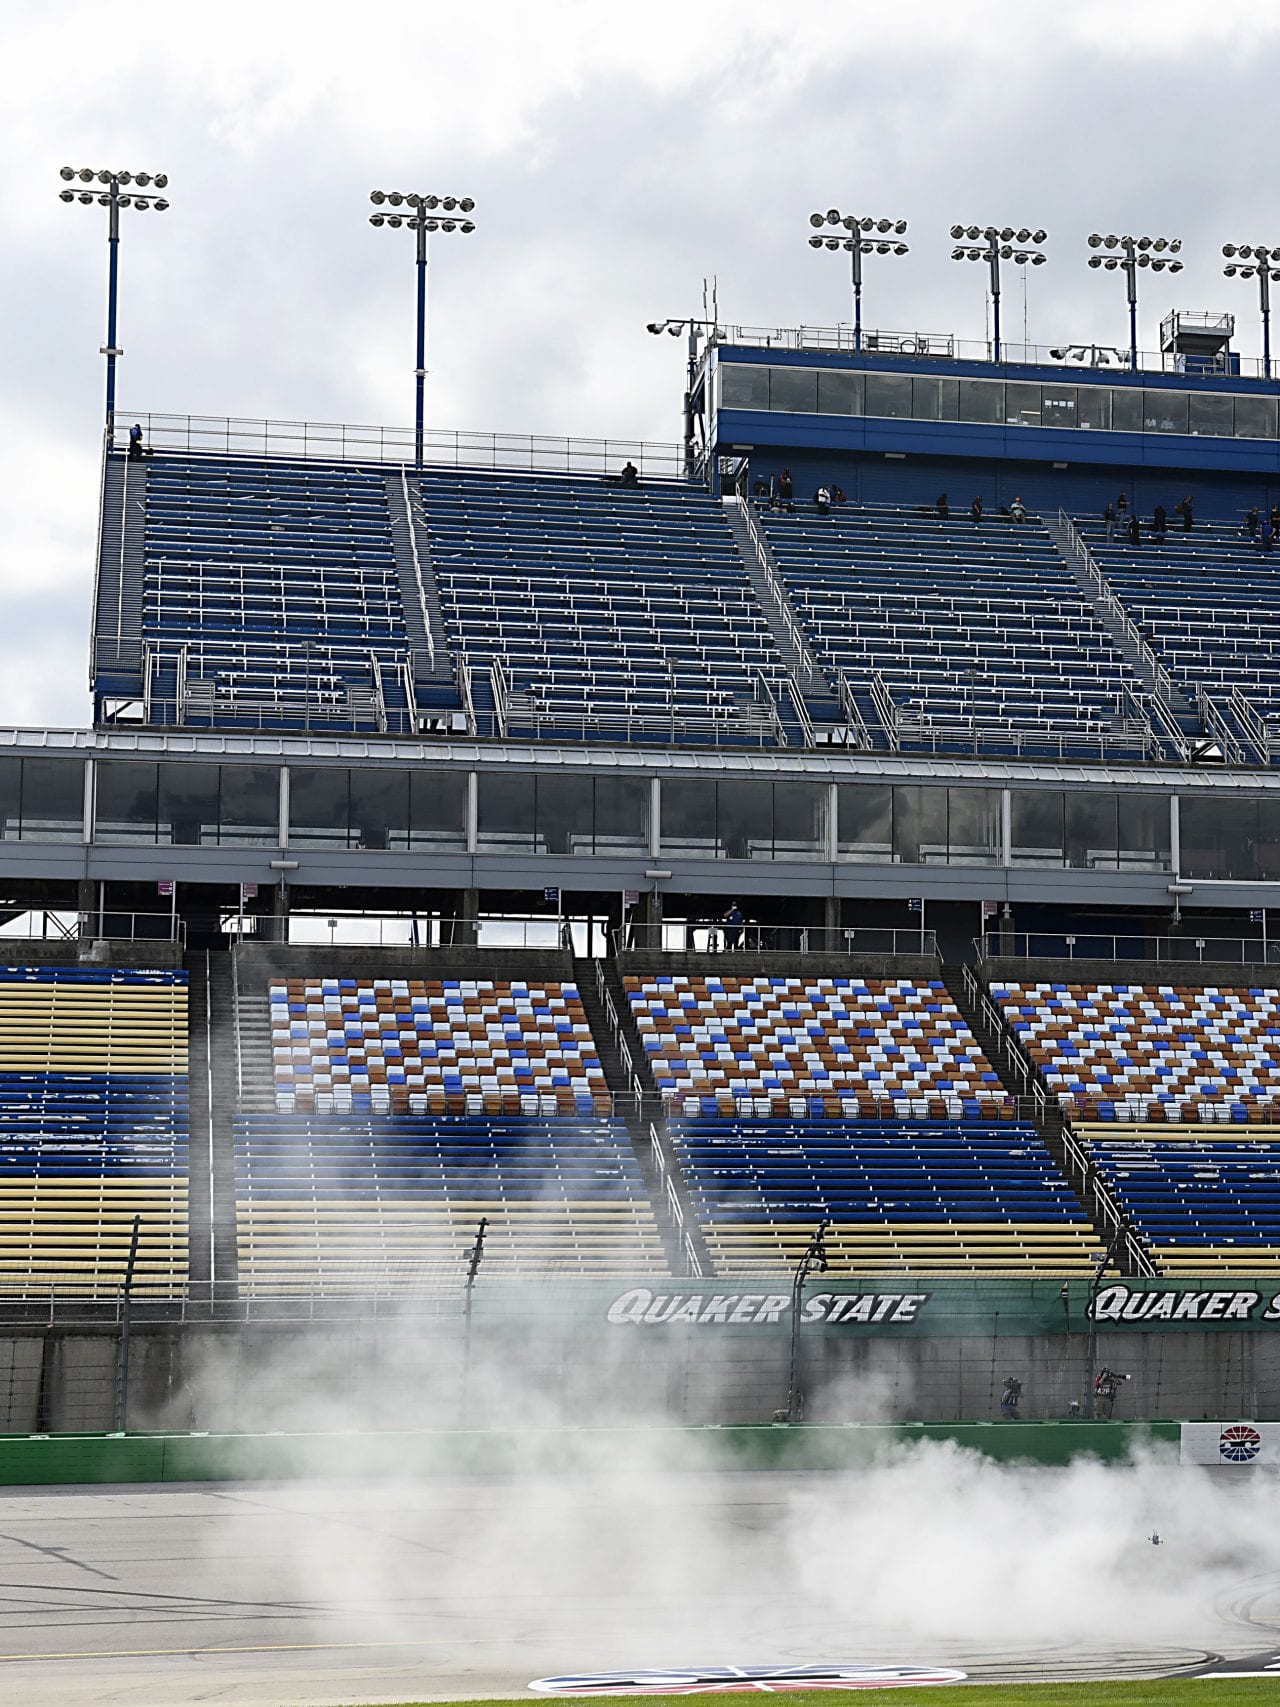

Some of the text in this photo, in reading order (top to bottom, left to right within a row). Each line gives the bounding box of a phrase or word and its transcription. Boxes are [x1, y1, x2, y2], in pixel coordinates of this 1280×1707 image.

[606, 1287, 927, 1324] QUAKER STATE
[1088, 1285, 1260, 1324] QUAKER
